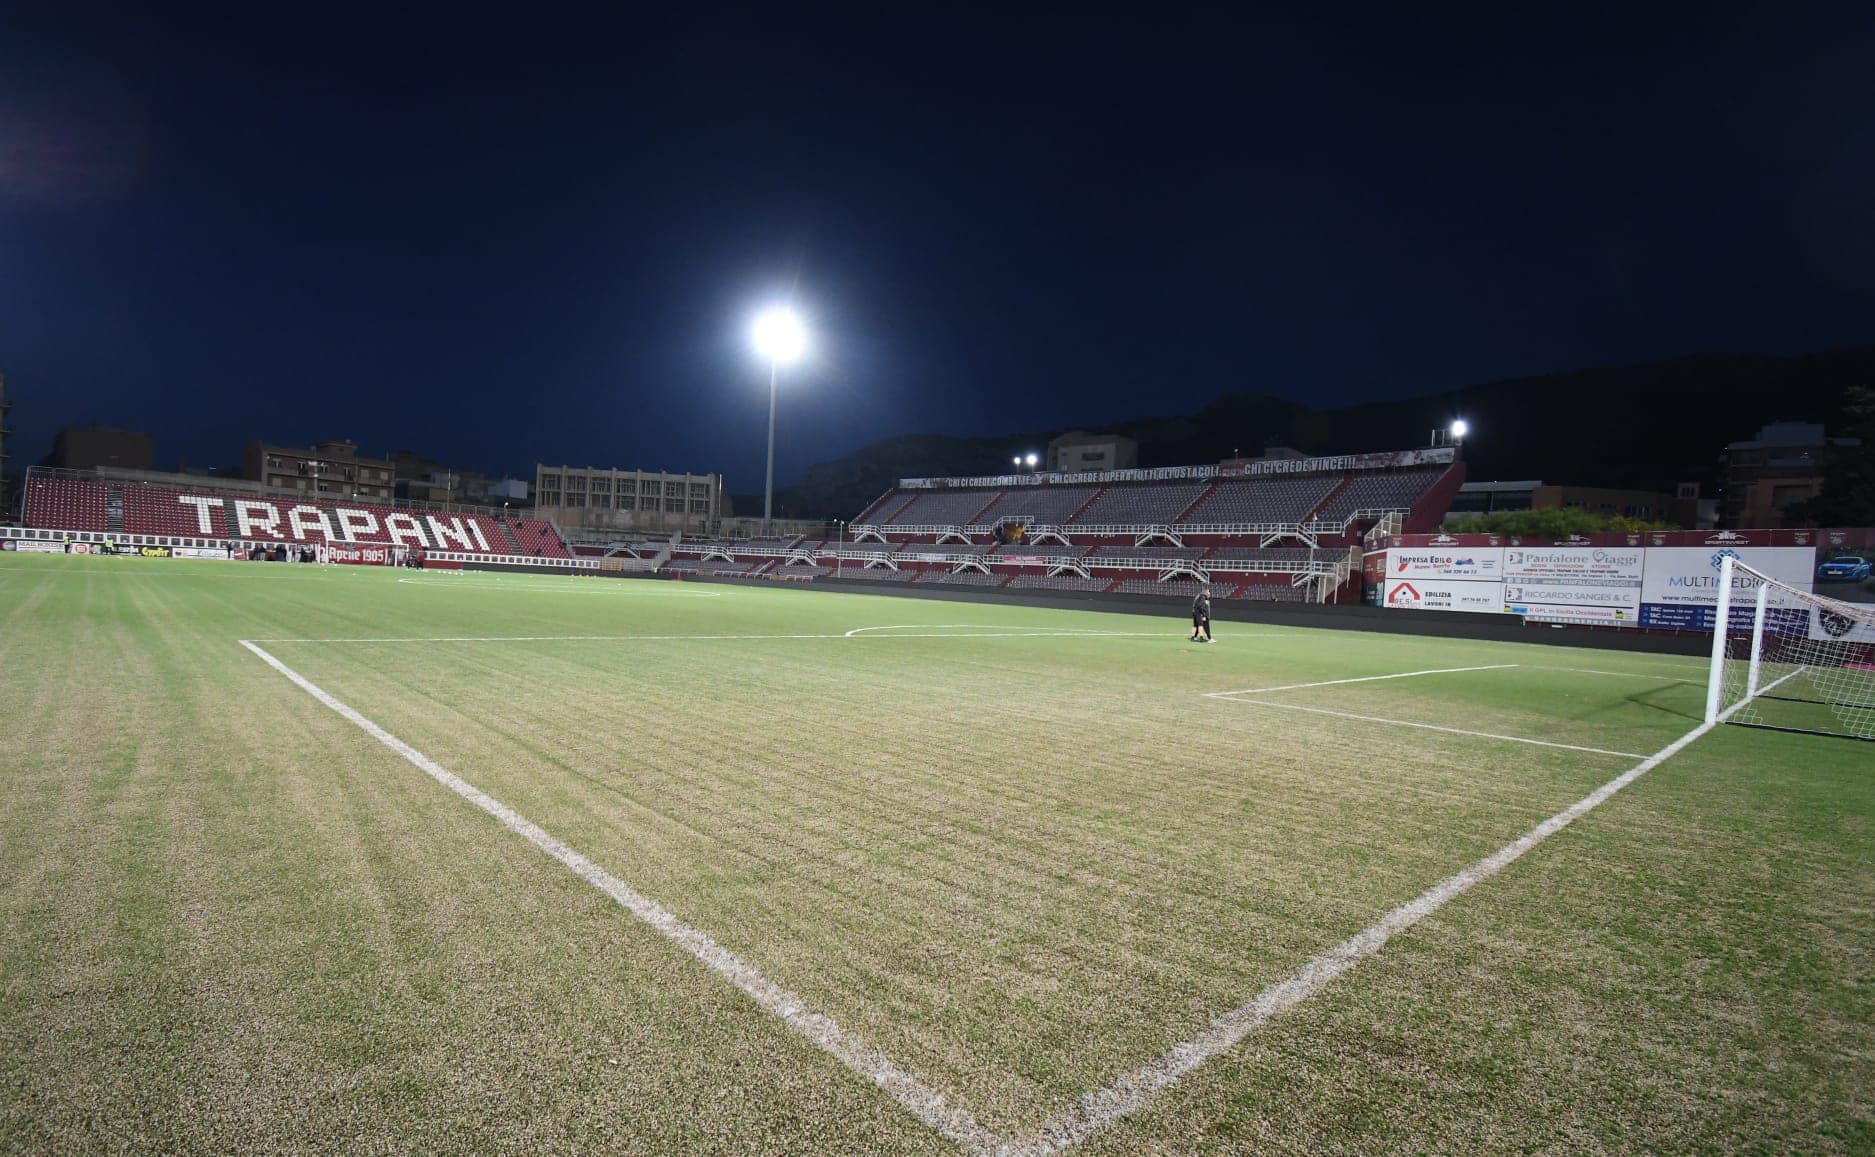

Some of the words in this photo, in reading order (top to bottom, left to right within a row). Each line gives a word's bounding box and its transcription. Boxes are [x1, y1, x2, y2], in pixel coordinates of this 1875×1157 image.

[1276, 460, 1308, 473] CREDE
[179, 496, 490, 551] TRAPANI
[363, 549, 384, 562] 1905
[1525, 591, 1573, 599] RICCARDO
